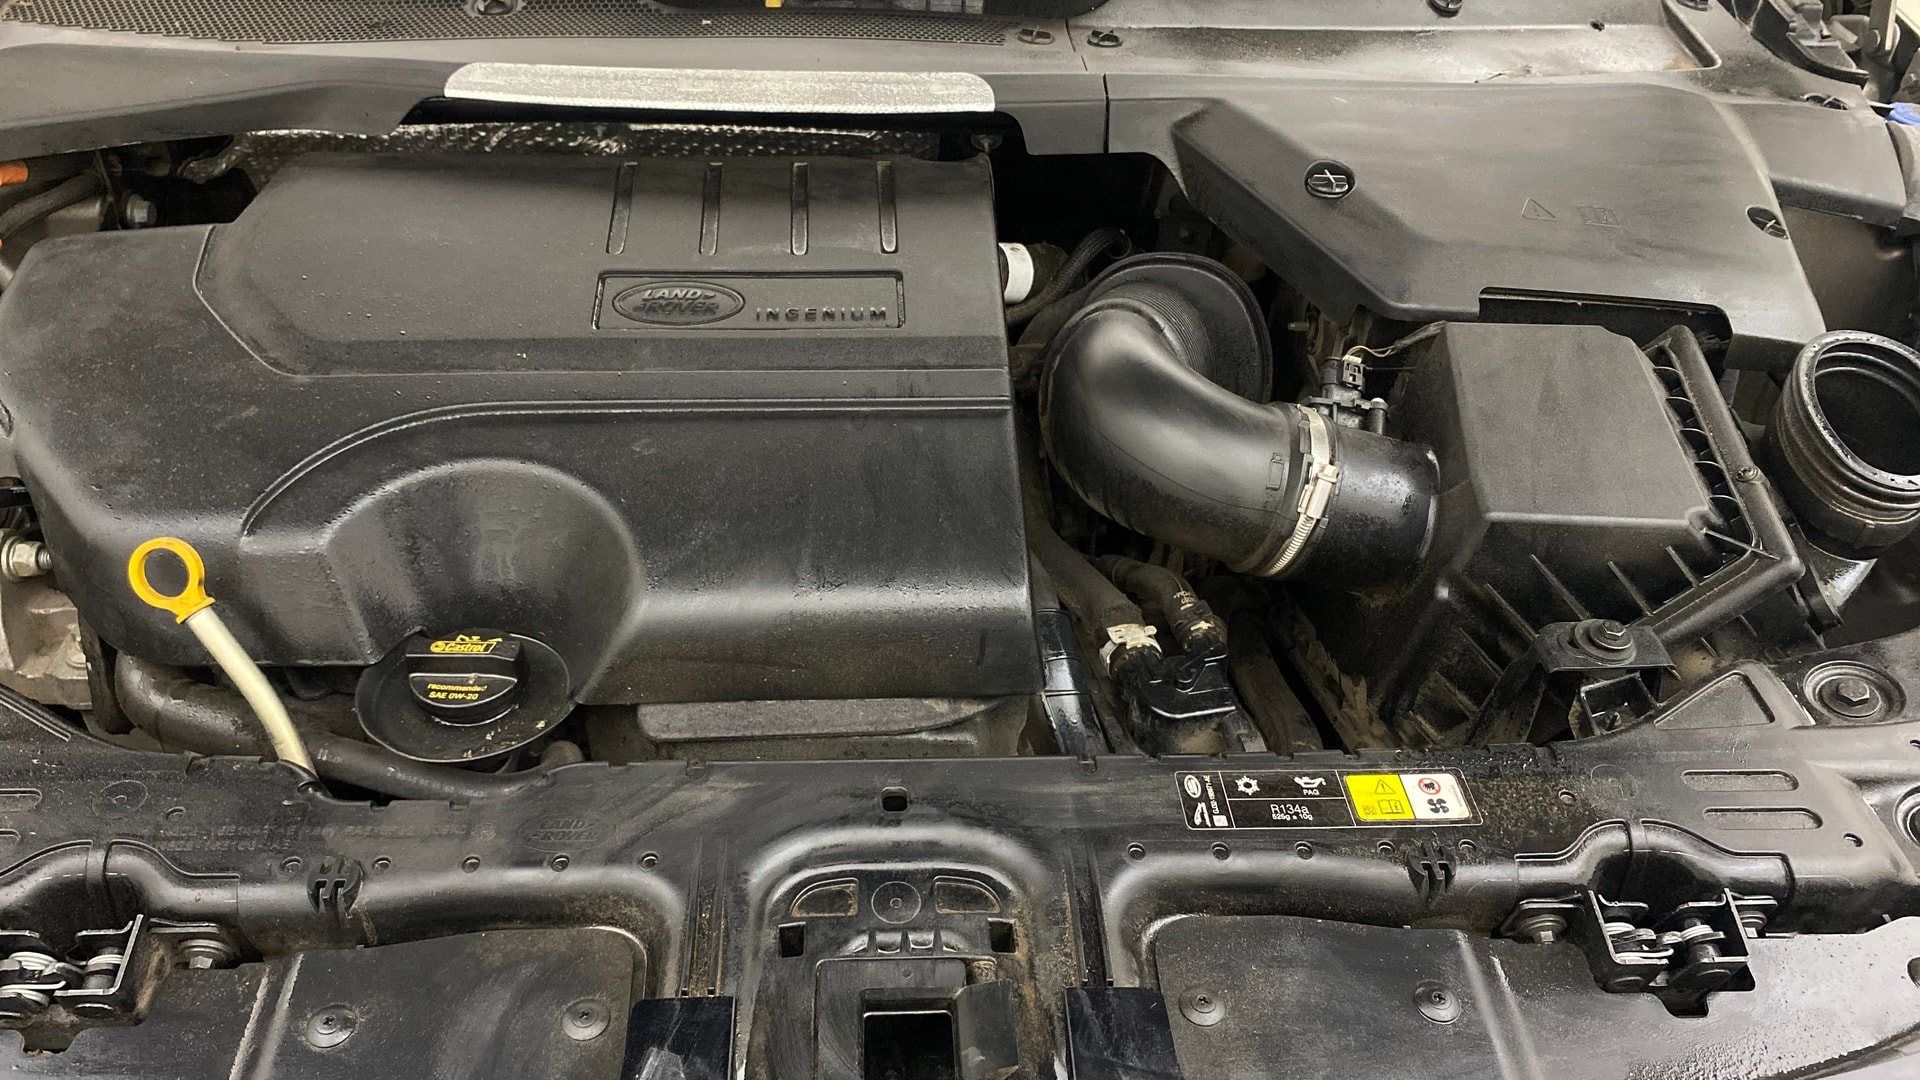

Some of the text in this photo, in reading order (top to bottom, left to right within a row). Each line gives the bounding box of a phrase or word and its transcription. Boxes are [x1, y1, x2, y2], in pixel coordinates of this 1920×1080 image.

[756, 306, 887, 321] INGENIUM
[445, 643, 487, 652] Castrol
[427, 683, 488, 692] recommended
[428, 691, 448, 699] SAE
[1270, 803, 1310, 814] R134a
[1299, 813, 1314, 821] 10g
